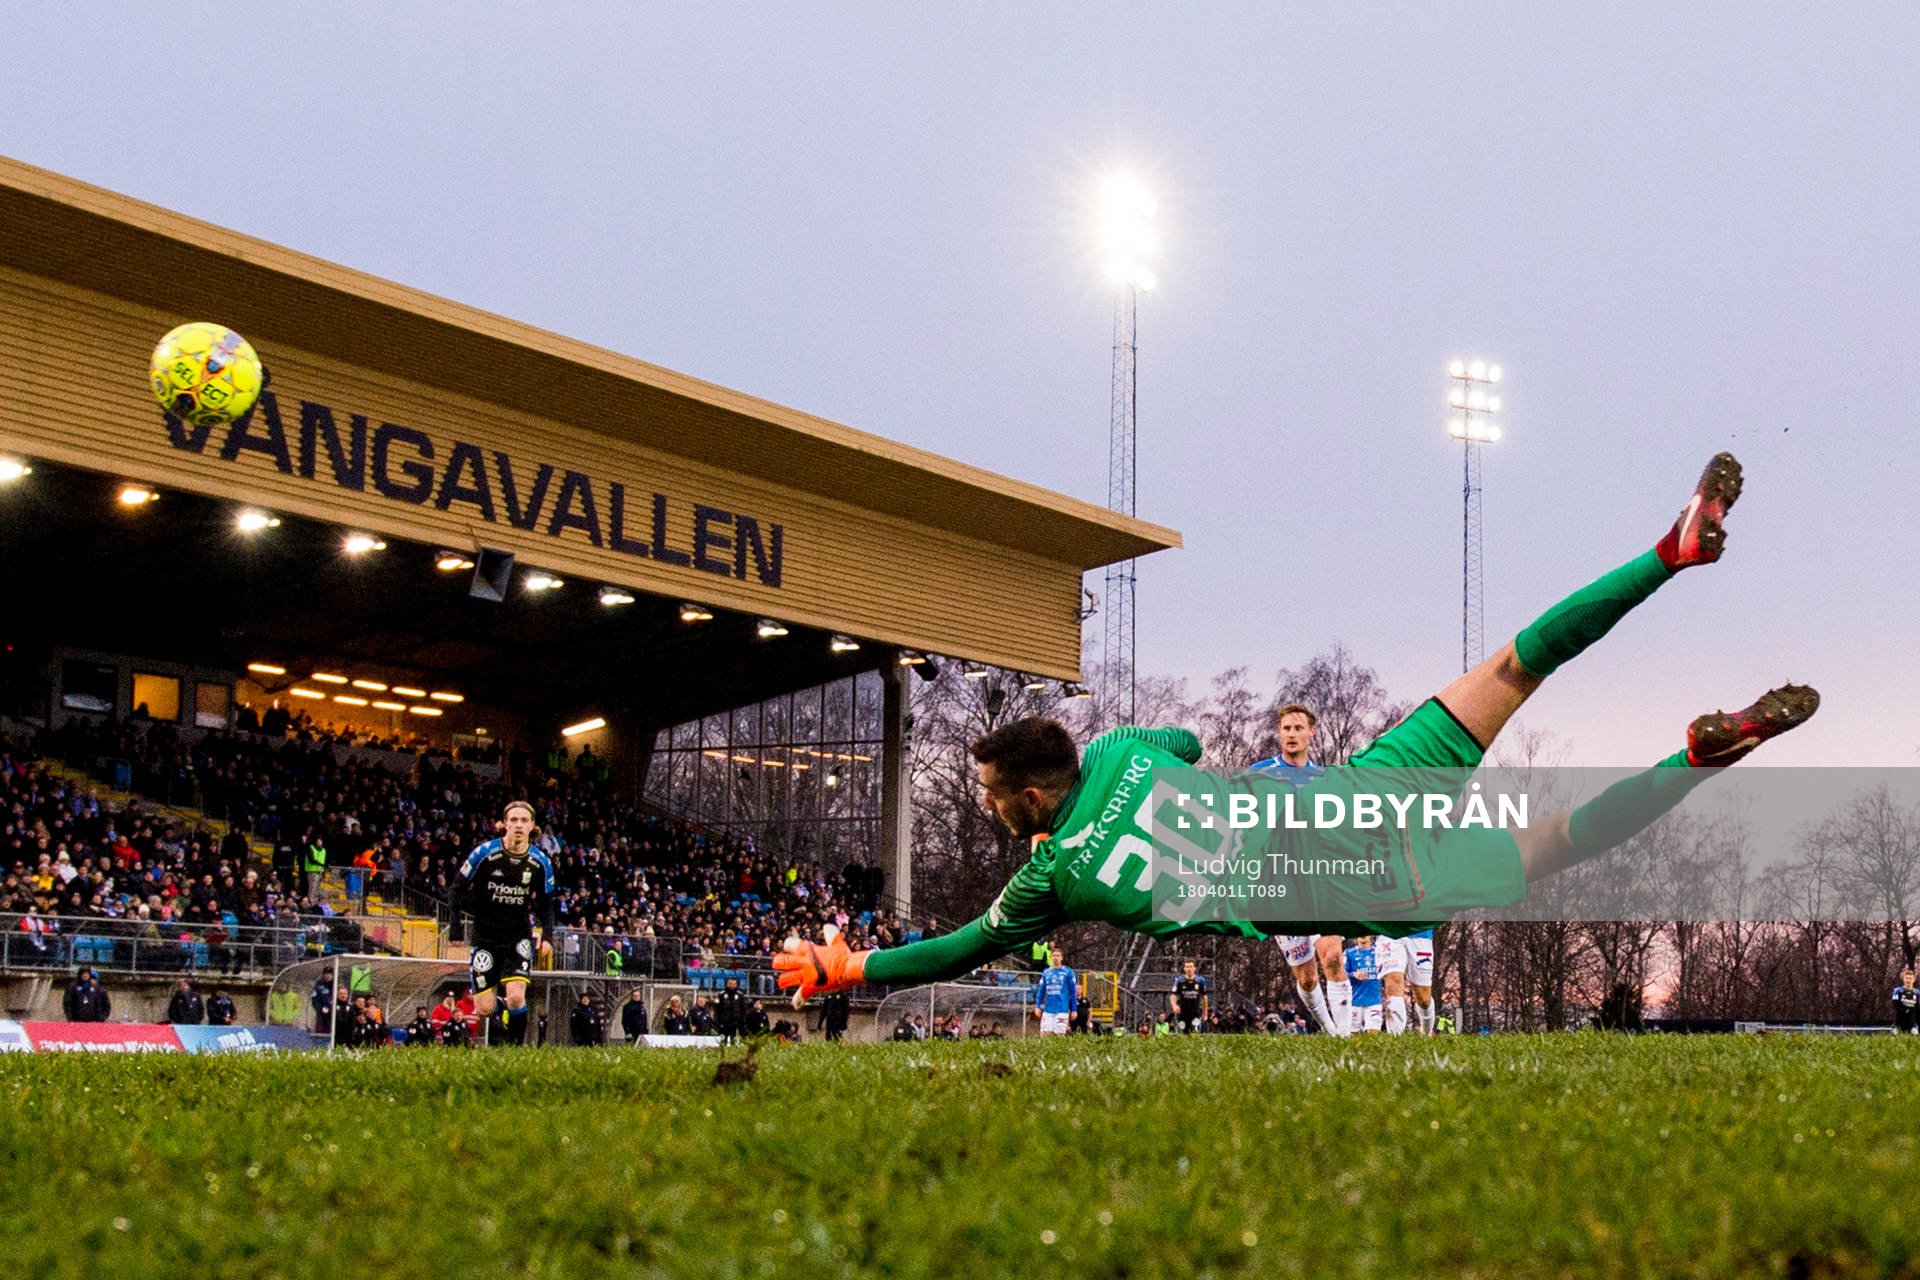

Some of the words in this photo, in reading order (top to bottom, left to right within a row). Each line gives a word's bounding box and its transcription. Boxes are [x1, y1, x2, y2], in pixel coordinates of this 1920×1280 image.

[174, 361, 195, 385] SEL
[201, 383, 228, 404] ECT
[1067, 754, 1153, 880] ERIKSBERG
